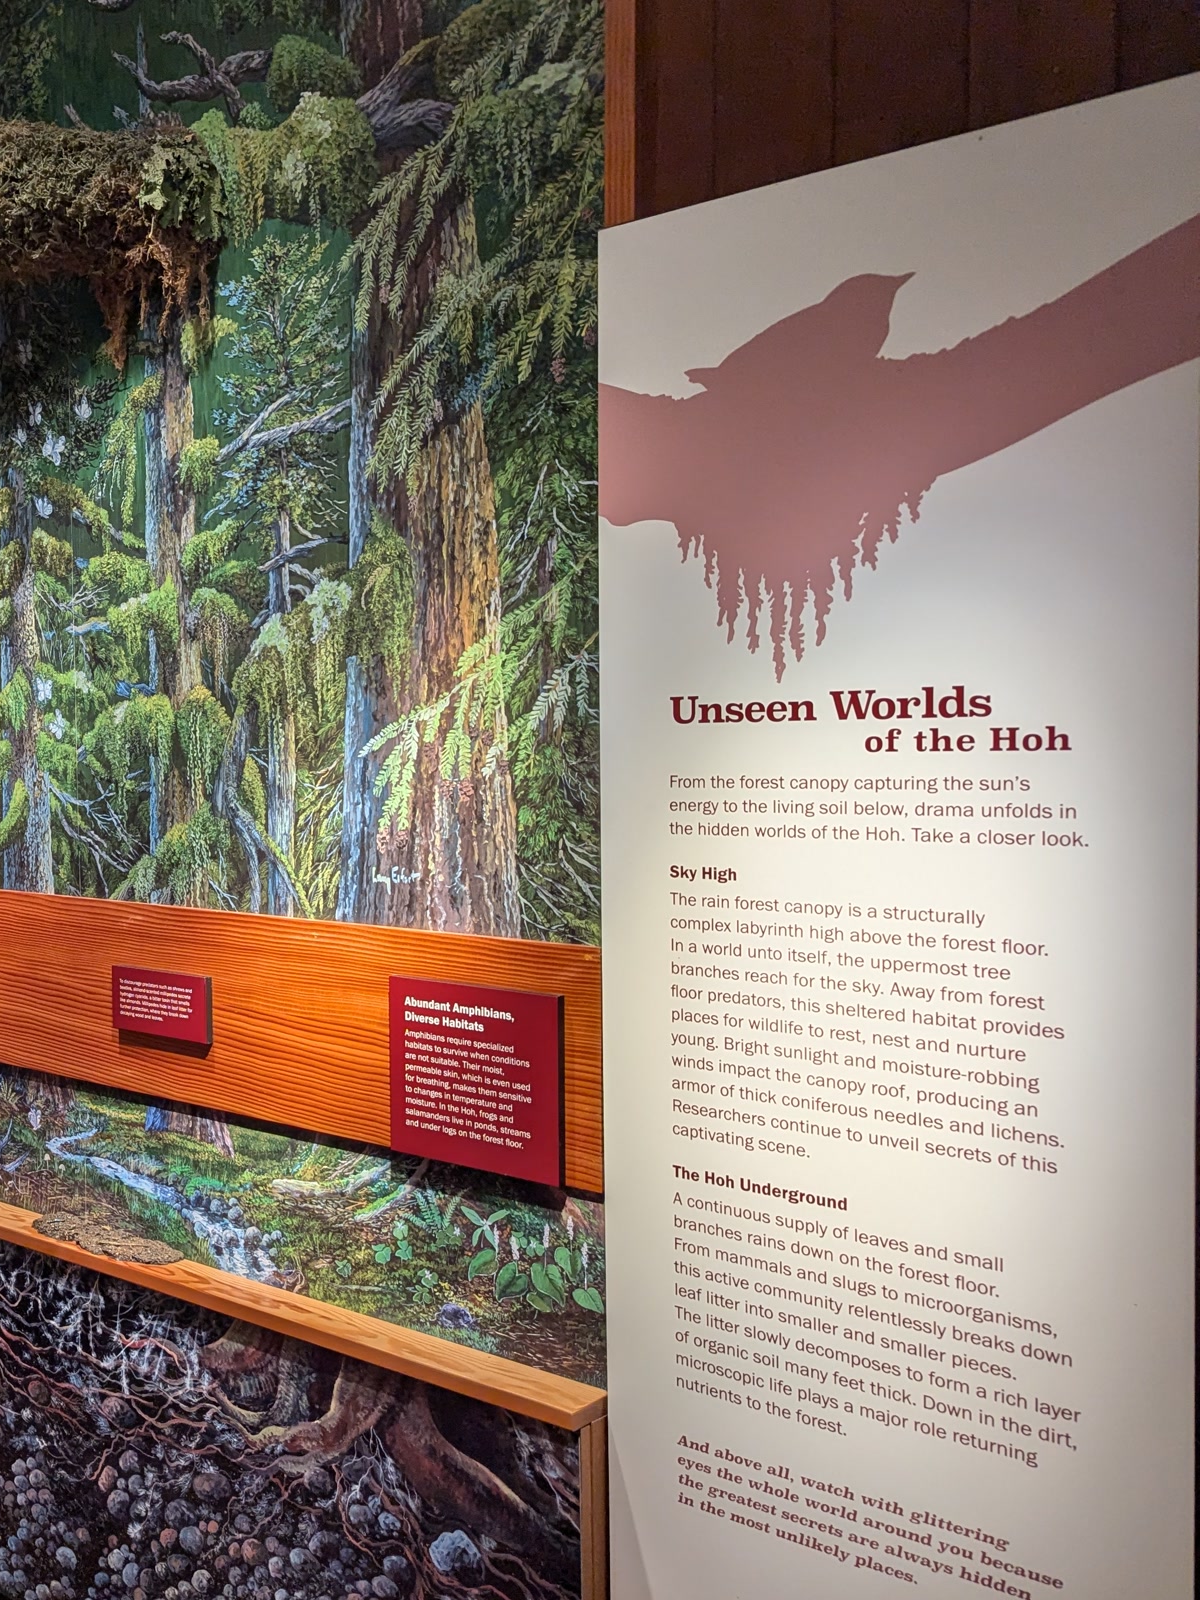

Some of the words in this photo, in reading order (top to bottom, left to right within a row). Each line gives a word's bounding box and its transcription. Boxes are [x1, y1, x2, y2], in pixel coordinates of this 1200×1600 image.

[670, 696, 817, 724] Unseen
[830, 686, 992, 720] Worlds
[865, 728, 901, 752] of
[914, 728, 975, 752] the
[990, 726, 1072, 751] Hoh
[670, 775, 705, 788] From
[710, 776, 734, 788] the
[740, 775, 784, 789] forest
[790, 779, 848, 792] canopy
[854, 776, 938, 794] capturing
[943, 776, 973, 790] the
[980, 776, 1030, 791] sun’s
[670, 801, 718, 815] energy
[723, 800, 737, 812] to
[742, 800, 767, 813] the
[774, 800, 814, 817] living
[820, 801, 847, 814] soil
[854, 801, 908, 817] below,
[915, 802, 973, 817] drama
[982, 803, 1052, 818] unfolds
[1060, 804, 1076, 818] in
[669, 822, 692, 835] the
[698, 822, 748, 836] hidden
[755, 825, 806, 838] worlds
[812, 825, 828, 839] of
[832, 826, 859, 840] the
[866, 827, 904, 841] Hoh.
[912, 828, 953, 843] Take
[960, 832, 970, 843] a
[978, 830, 1035, 845] closer
[1042, 831, 1088, 847] look.
[670, 865, 697, 882] Sky
[702, 867, 736, 883] High
[670, 892, 696, 906] The
[702, 895, 729, 908] rain
[735, 896, 779, 912] forest
[785, 902, 842, 918] canopy
[849, 903, 861, 917] is
[868, 907, 876, 918] a
[884, 907, 985, 928] structurally
[671, 918, 731, 933] complex
[737, 920, 803, 938] labyrinth
[810, 926, 843, 943] high
[850, 929, 901, 945] above
[907, 933, 936, 948] the
[942, 934, 996, 952] forest
[1002, 939, 1048, 956] floor.
[672, 938, 683, 951] In
[689, 943, 696, 952] a
[702, 943, 741, 956] world
[748, 947, 782, 960] unto
[788, 948, 831, 966] itself,
[837, 953, 864, 967] the
[871, 958, 967, 976] uppermost
[973, 964, 1010, 980] tree
[672, 961, 739, 980] branches
[745, 972, 787, 984] reach
[793, 973, 815, 987] for
[820, 976, 846, 990] the
[852, 980, 883, 997] sky.
[890, 982, 934, 1002] Away
[940, 986, 982, 1004] from
[989, 991, 1045, 1010] forest
[404, 996, 450, 1012] Abundant
[452, 1003, 514, 1022] Amphibians,
[405, 1011, 440, 1025] Diverse
[442, 1016, 484, 1032] Habitats
[405, 1029, 445, 1042] Amphibians
[447, 1037, 471, 1046] require
[474, 1041, 514, 1053] specialized
[405, 1040, 433, 1051] habitats
[443, 1048, 468, 1057] survive
[470, 1052, 489, 1060] when
[491, 1056, 530, 1068] conditions
[673, 1125, 754, 1151] captivating
[758, 1140, 810, 1158] scene.
[672, 1165, 699, 1181] The
[705, 1171, 734, 1188] Hoh
[740, 1178, 847, 1210] Underground
[673, 1192, 682, 1205] A
[688, 1198, 770, 1223] continuous
[776, 1216, 827, 1238] supply
[833, 1227, 849, 1240] of
[855, 1229, 908, 1252] leaves
[914, 1244, 947, 1260] and
[954, 1252, 1003, 1272] small
[677, 1377, 742, 1404] nutrients
[746, 1396, 761, 1410] to
[766, 1401, 791, 1419] the
[796, 1409, 846, 1436] forest.
[677, 1436, 709, 1454] And
[714, 1449, 762, 1470] above
[767, 1466, 794, 1483] all,
[801, 1476, 854, 1500] watch
[862, 1496, 904, 1516] with
[909, 1512, 1009, 1552] glittering
[678, 1457, 711, 1474] eyes
[717, 1468, 742, 1484] the
[748, 1480, 799, 1502] whole
[805, 1498, 857, 1522] world
[863, 1518, 932, 1546] around
[938, 1542, 973, 1560] you
[981, 1551, 1063, 1588] because
[678, 1492, 694, 1507] in
[700, 1501, 725, 1517] the
[730, 1513, 770, 1533] most
[776, 1528, 850, 1562] unlikely
[854, 1556, 917, 1584] places.
[679, 1474, 703, 1490] the
[708, 1487, 776, 1515] greatest
[781, 1511, 842, 1537] secrets
[848, 1534, 879, 1549] are
[884, 1545, 953, 1574] always
[959, 1566, 1030, 1600] hidden
